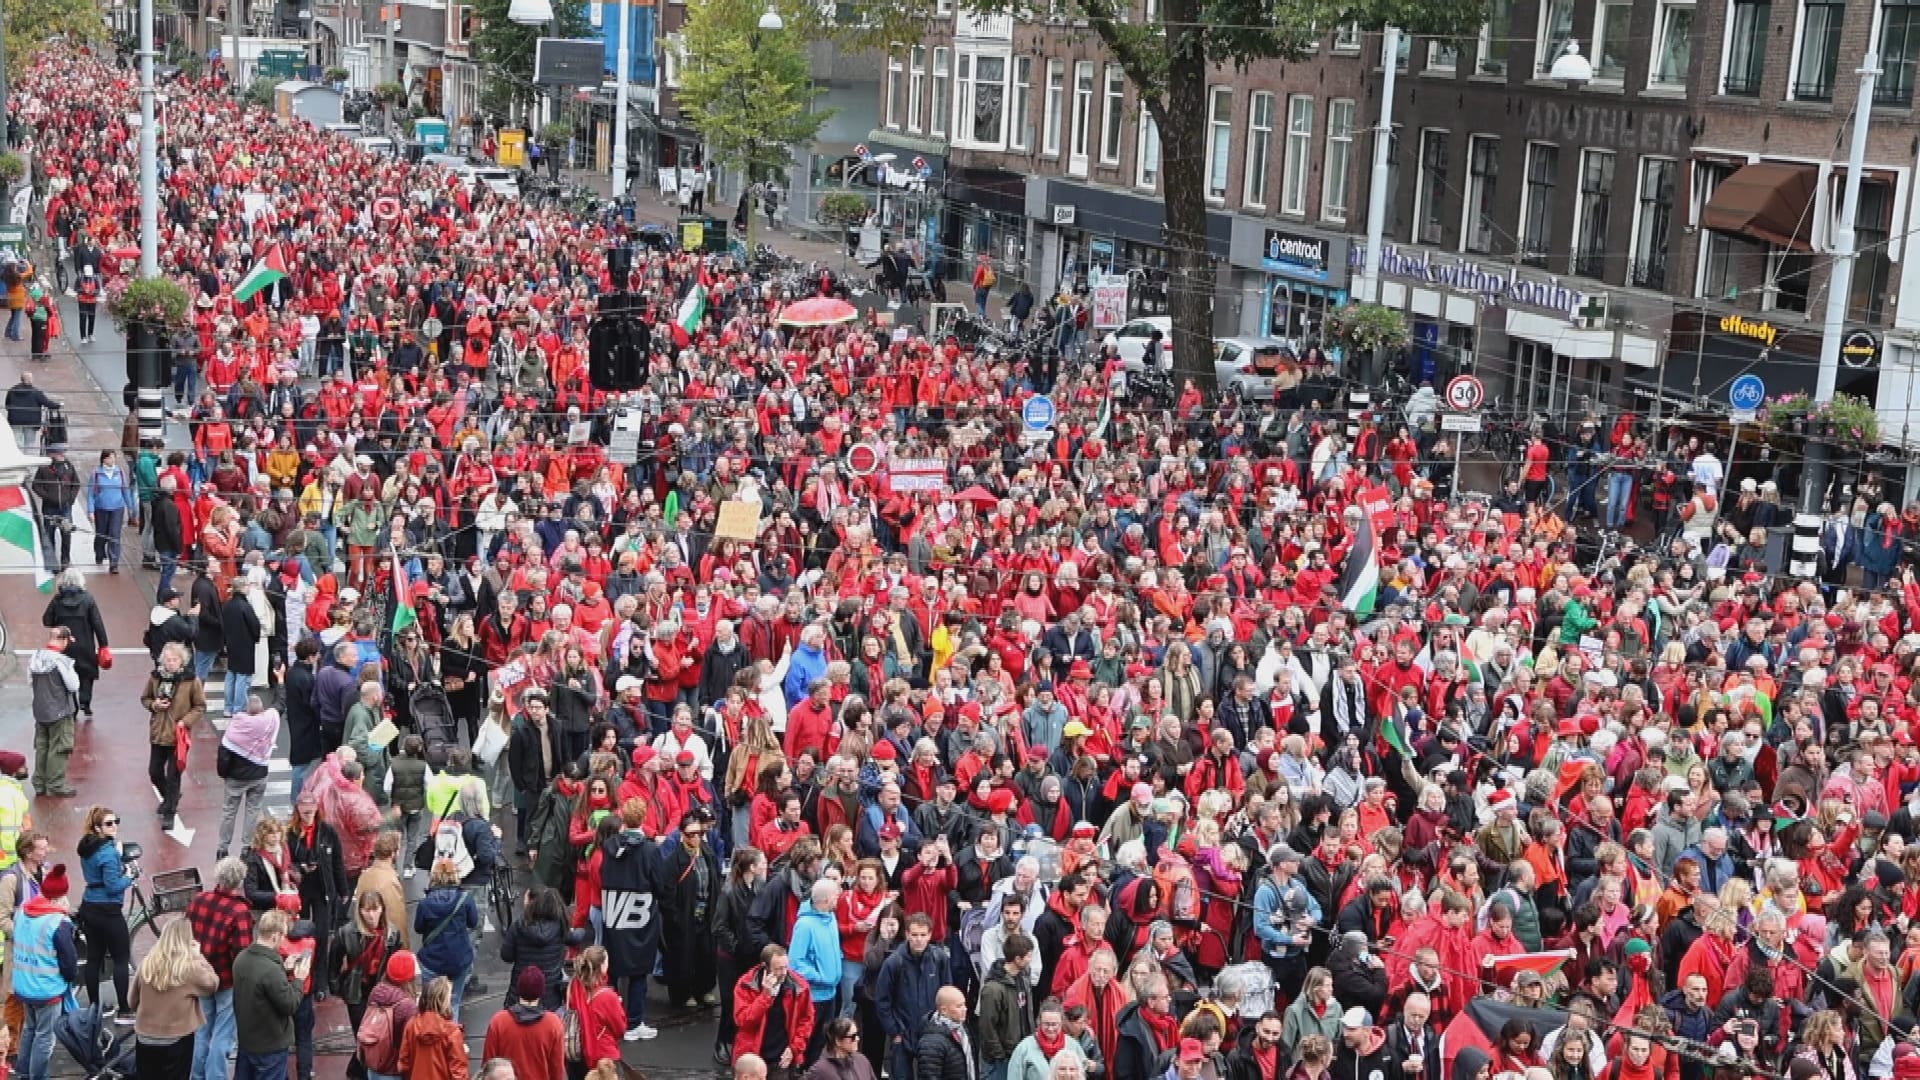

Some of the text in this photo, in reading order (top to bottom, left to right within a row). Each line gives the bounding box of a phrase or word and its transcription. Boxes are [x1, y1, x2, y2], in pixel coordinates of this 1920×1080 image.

[1526, 101, 1684, 151] APOTHEEK
[1280, 239, 1322, 260] centraal
[1720, 315, 1777, 346] effendy
[1455, 386, 1476, 400] 30
